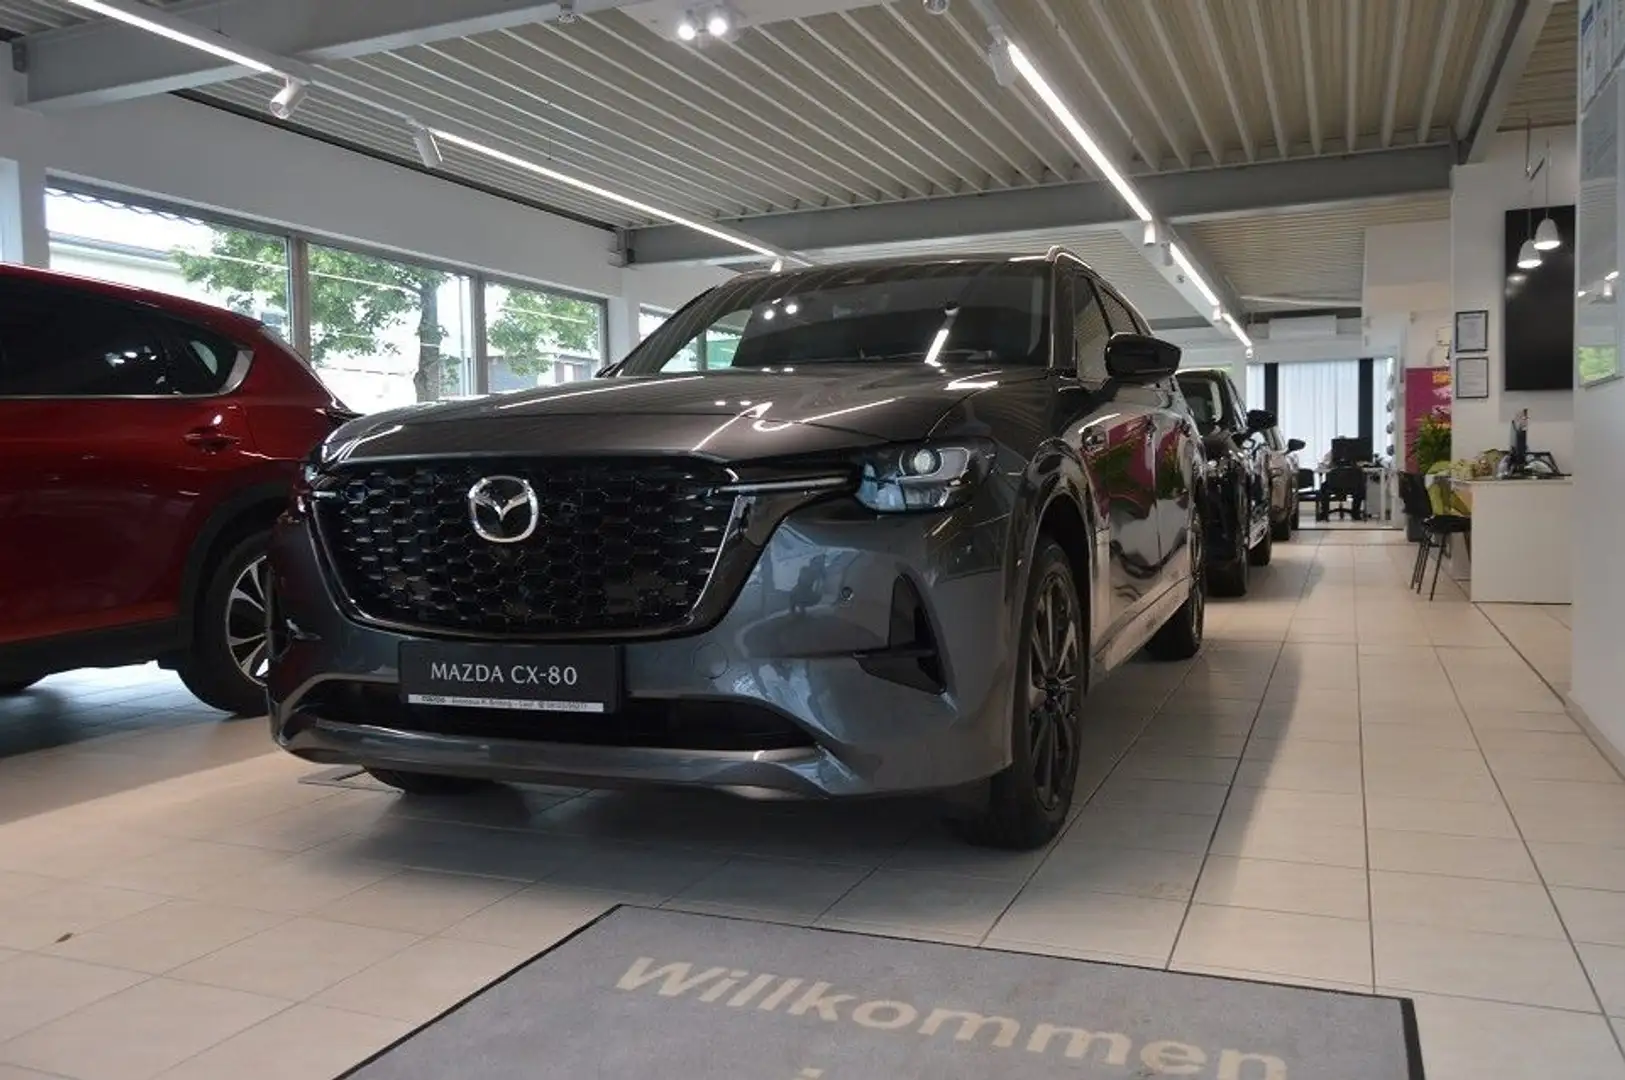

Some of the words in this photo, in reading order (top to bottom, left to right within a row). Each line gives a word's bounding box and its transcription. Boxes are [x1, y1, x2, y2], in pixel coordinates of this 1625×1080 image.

[431, 663, 504, 683] MAZDA
[511, 665, 578, 685] CX-80
[615, 956, 1289, 1080] Willkommen
